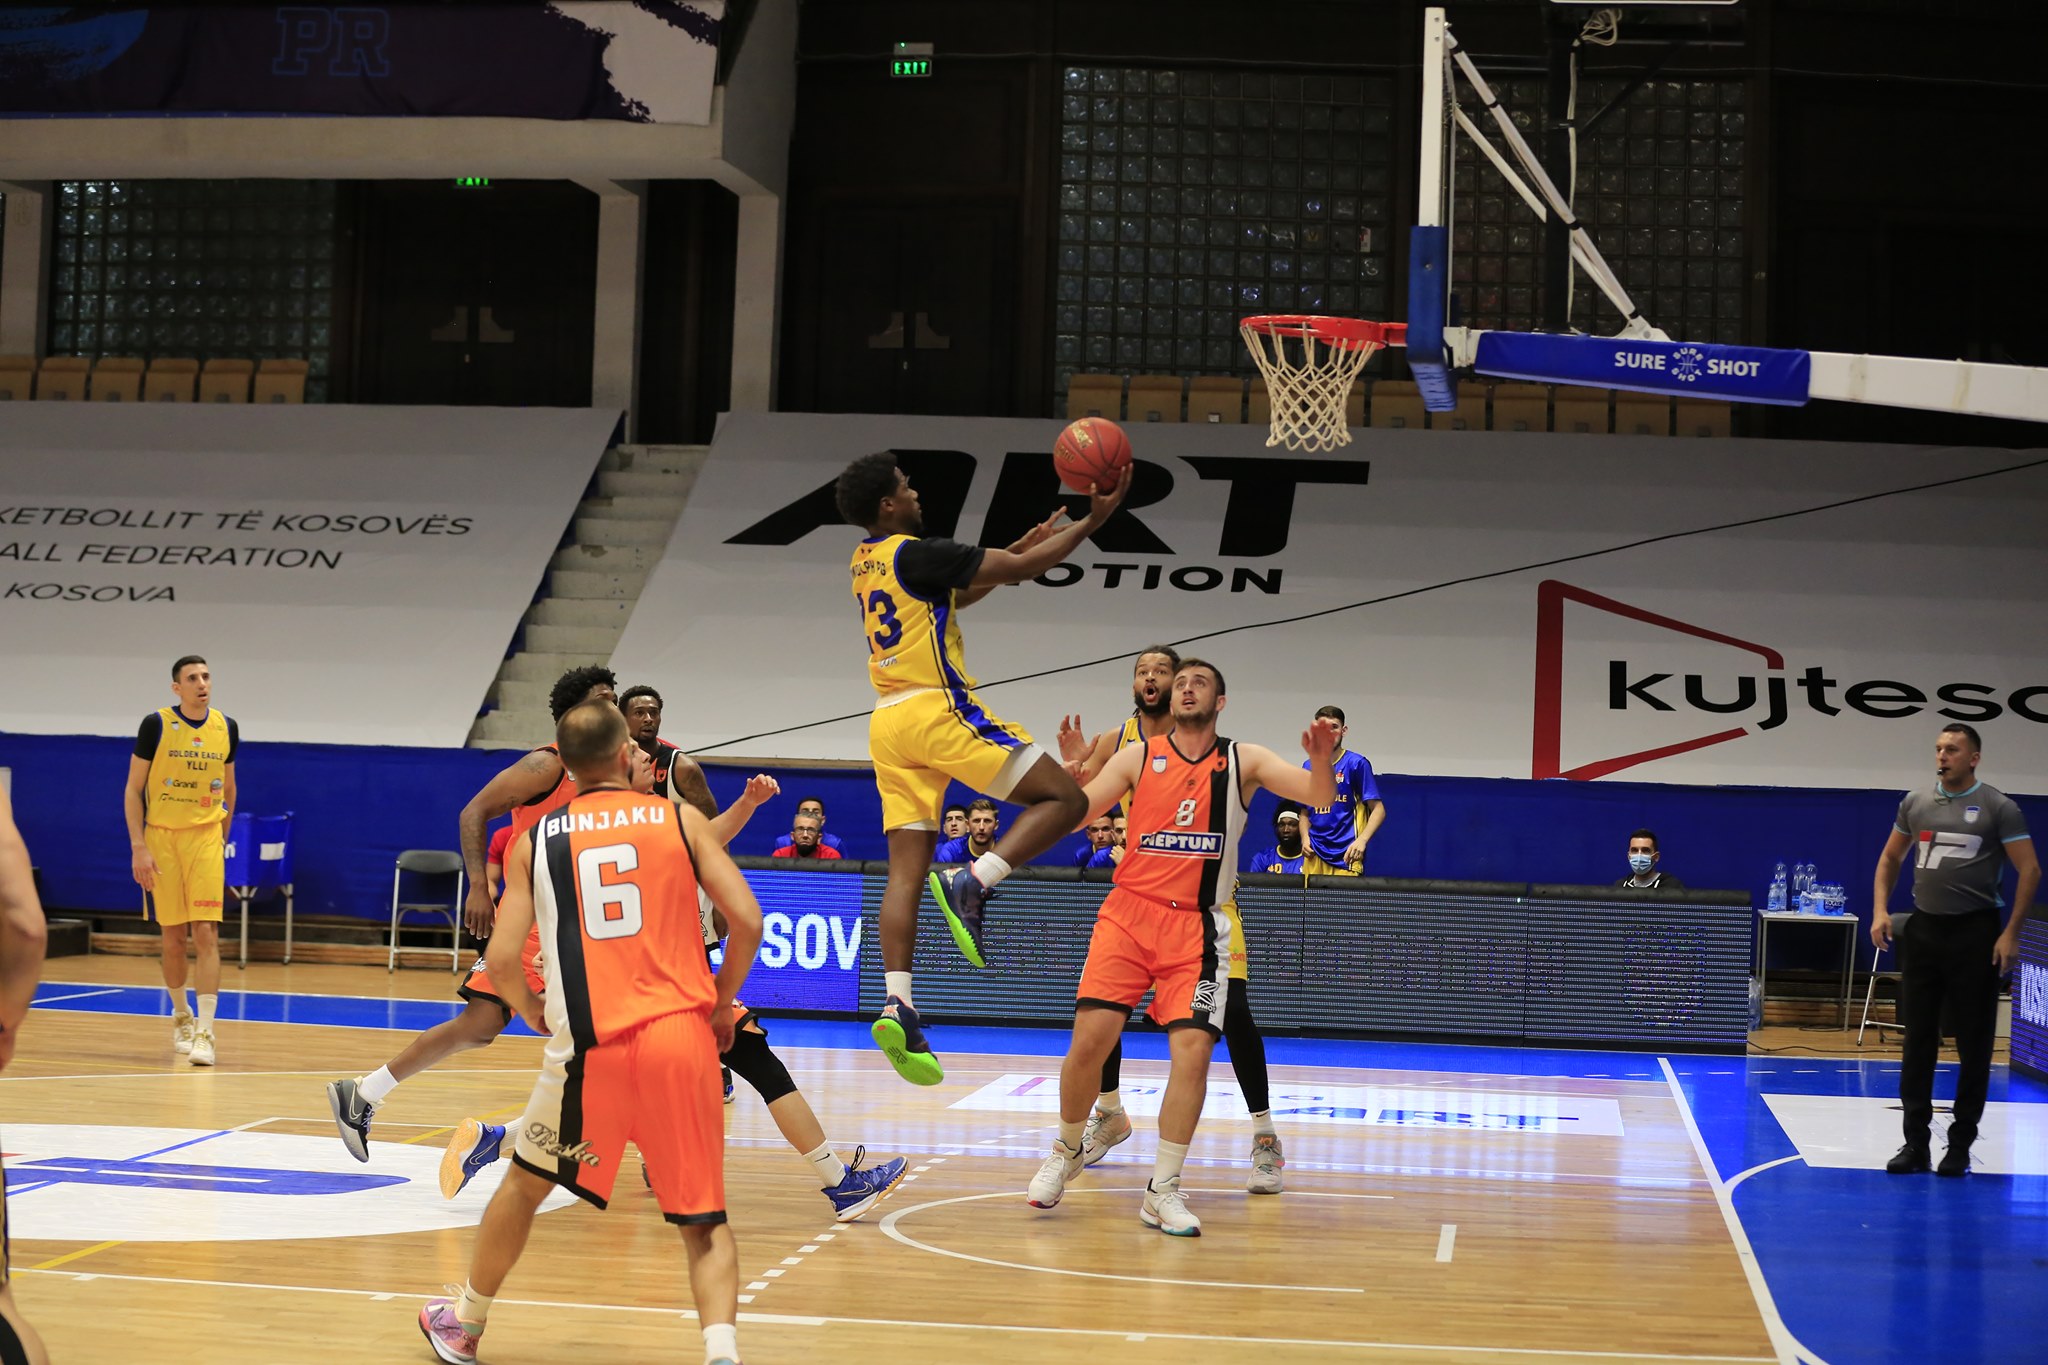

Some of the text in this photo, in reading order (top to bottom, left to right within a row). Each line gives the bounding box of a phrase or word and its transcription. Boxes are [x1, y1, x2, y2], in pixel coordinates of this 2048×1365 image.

[272, 7, 390, 76] PR
[894, 61, 928, 75] EXIT
[1614, 352, 1761, 377] SURE SHOT
[216, 510, 264, 531] TË
[272, 514, 474, 535] KOSOVËS
[77, 543, 343, 570] FEDERATION
[1003, 563, 1283, 594] OTION
[4, 582, 176, 602] KOSOVA
[168, 750, 223, 760] GOLDEN EAGLE
[187, 761, 208, 770] YLLI
[547, 806, 665, 838] BUNJAKU
[1175, 798, 1197, 826] 8
[1142, 834, 1216, 850] NEPTUN
[577, 842, 643, 941] 6
